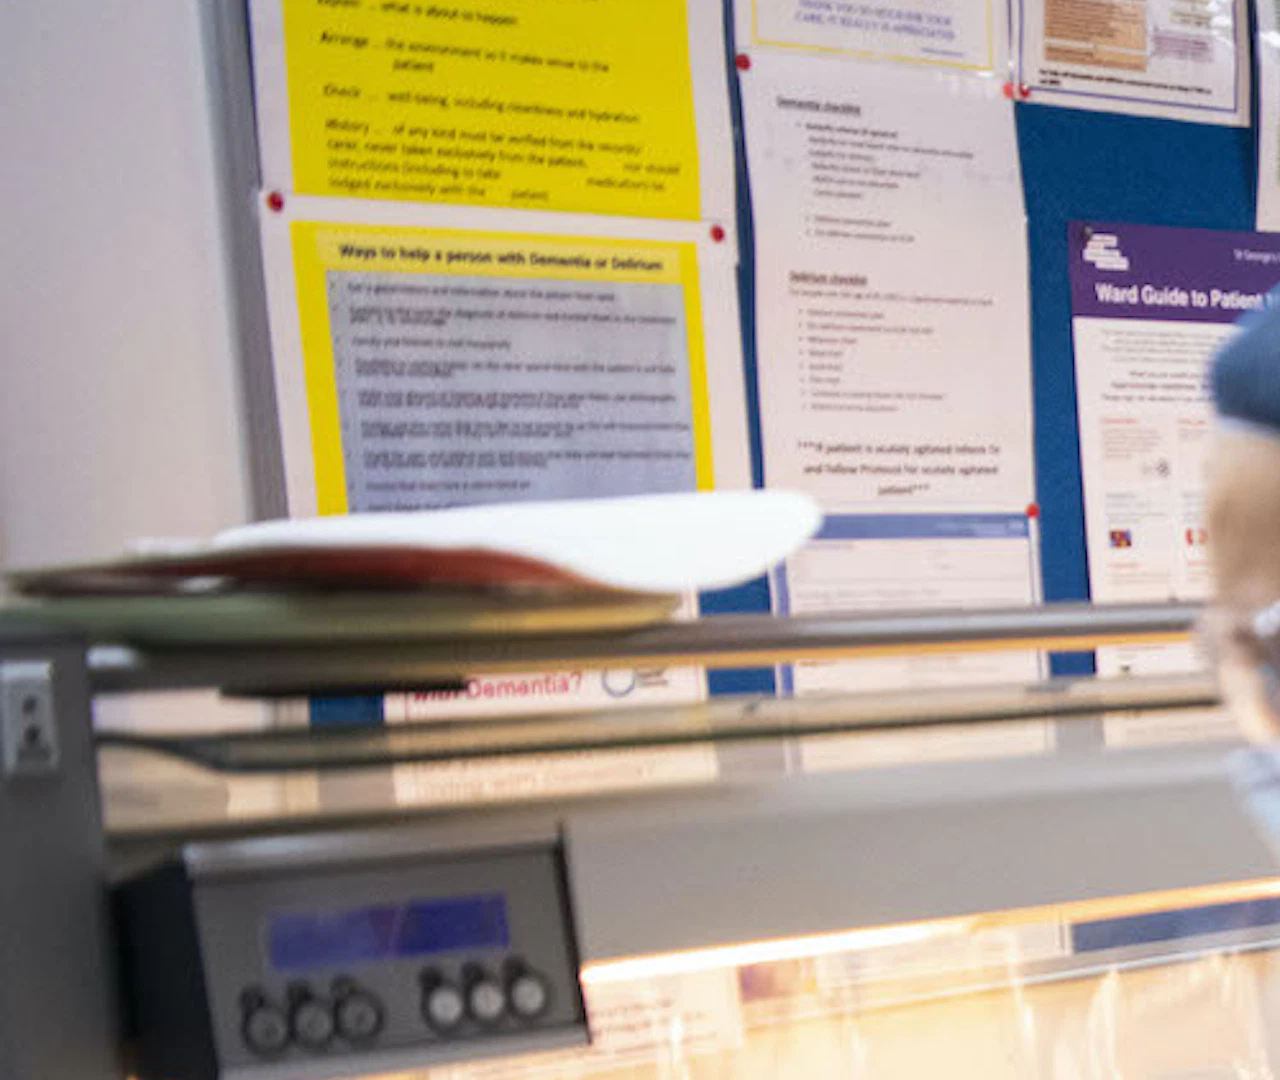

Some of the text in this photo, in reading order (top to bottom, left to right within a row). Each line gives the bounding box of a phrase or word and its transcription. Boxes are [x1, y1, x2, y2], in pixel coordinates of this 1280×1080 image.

[426, 6, 459, 20] about
[319, 31, 369, 49] Arrange
[408, 42, 482, 58] environment
[509, 52, 544, 66] makes
[591, 60, 610, 73] the
[392, 58, 435, 74] patient
[323, 83, 361, 99] Check
[454, 97, 505, 114] including
[567, 107, 587, 120] and
[588, 109, 640, 124] hydration
[325, 118, 370, 138] History
[408, 126, 429, 140] any
[431, 127, 457, 141] kind
[459, 130, 487, 143] must
[548, 136, 574, 149] from
[401, 144, 433, 157] taken
[436, 146, 496, 163] exclusively
[498, 149, 525, 163] from
[645, 162, 682, 176] should
[439, 184, 464, 198] with
[511, 189, 549, 203] patient
[339, 243, 378, 263] Ways
[381, 246, 397, 260] to
[399, 246, 431, 265] help
[447, 250, 493, 268] person
[496, 249, 527, 266] with
[530, 251, 593, 270] Dementia
[595, 256, 608, 270] or
[611, 255, 665, 273] Delirium
[1095, 283, 1264, 311] Ward Guide to Patient
[826, 443, 862, 456] patient
[914, 443, 952, 456] agitated
[804, 464, 823, 475] and
[958, 463, 999, 477] agitated
[465, 671, 586, 699] Dementia?
